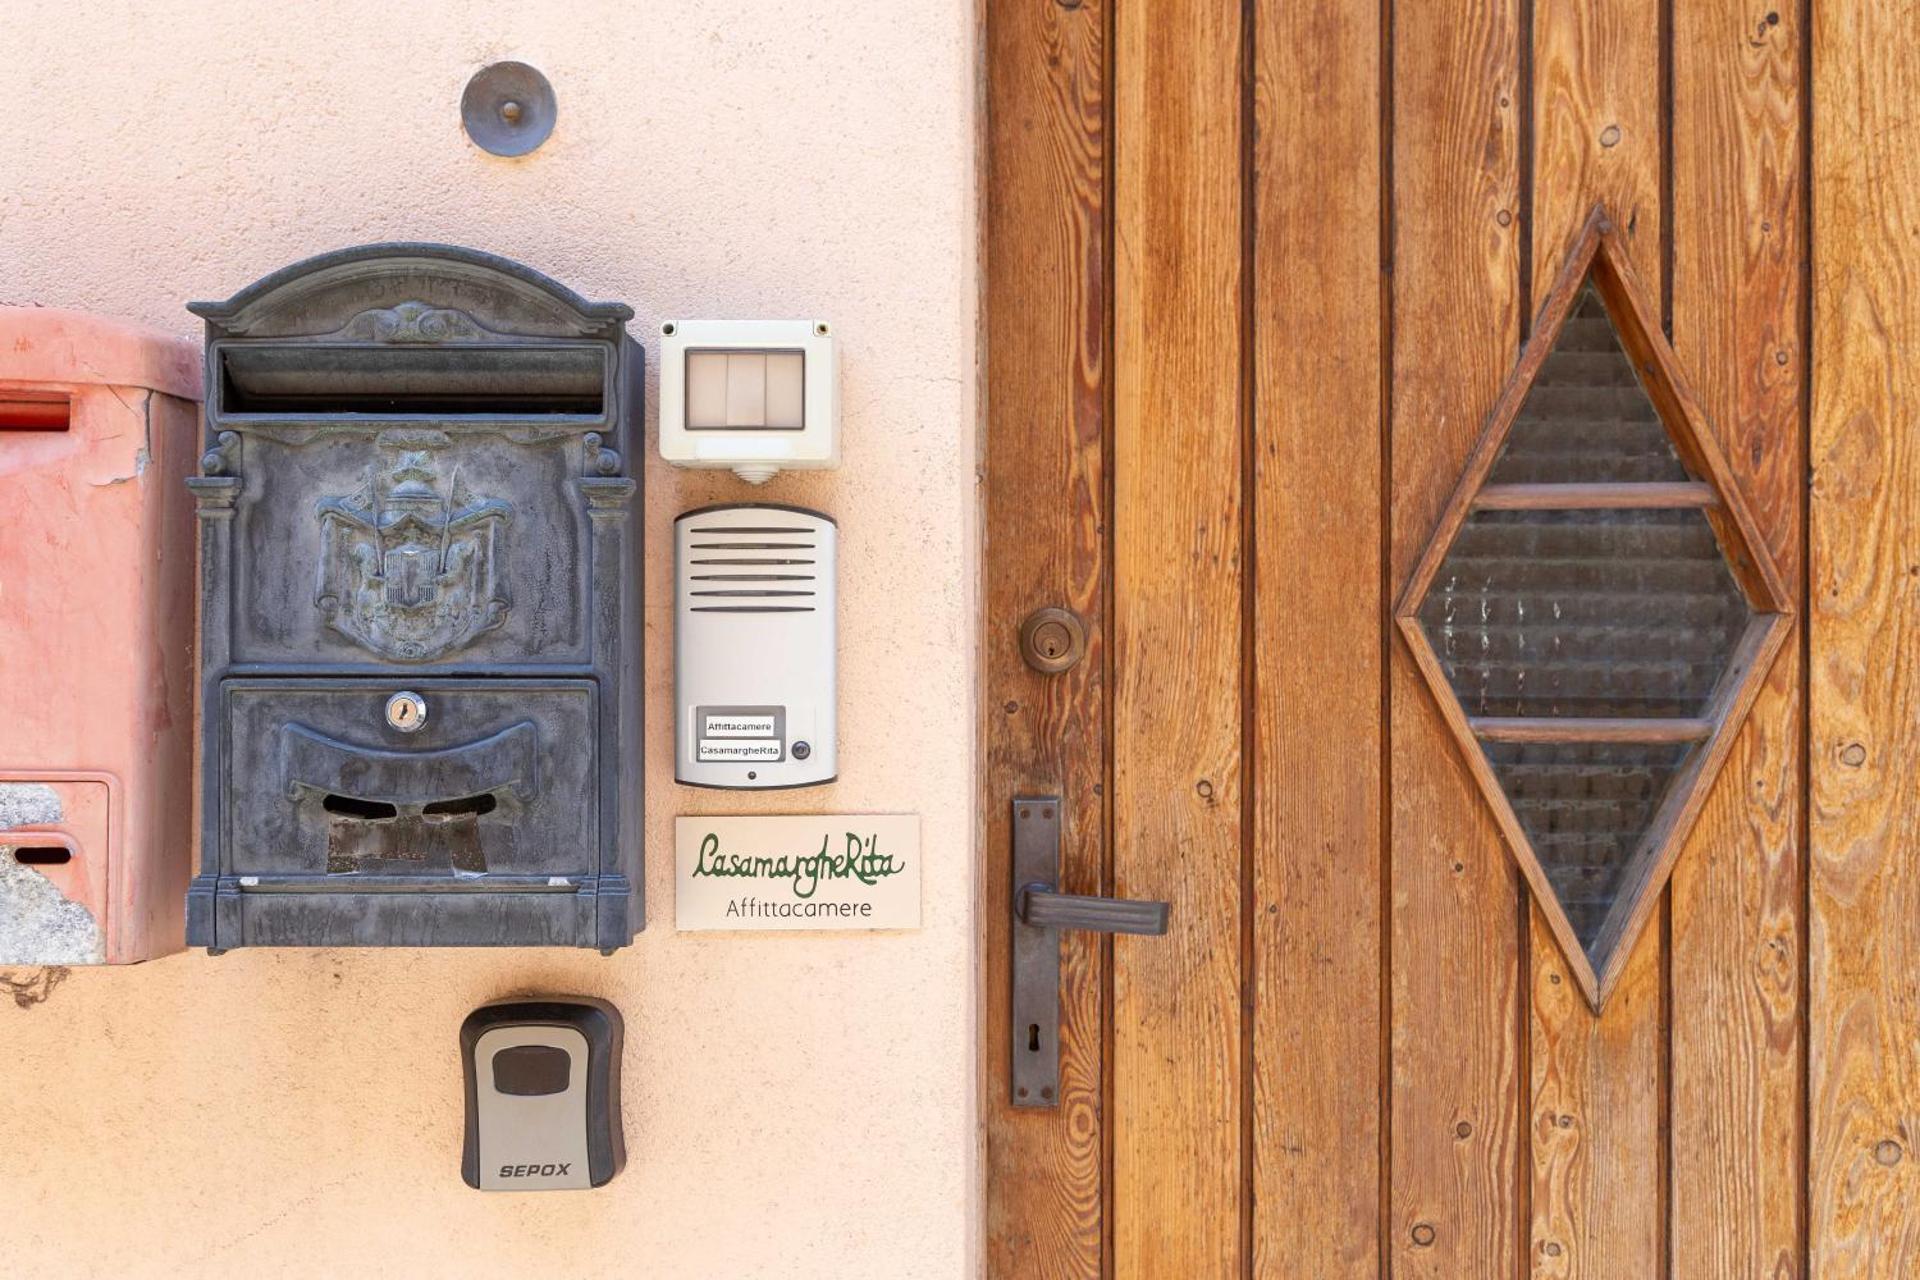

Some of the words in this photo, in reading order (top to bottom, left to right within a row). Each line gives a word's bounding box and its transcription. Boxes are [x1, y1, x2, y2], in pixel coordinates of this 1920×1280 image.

[708, 722, 771, 731] Affittacamere
[701, 746, 779, 756] CasamargheRita
[692, 832, 905, 899] CasamargheRita
[726, 897, 873, 917] Affittacamere
[499, 1163, 572, 1178] SEPOX
